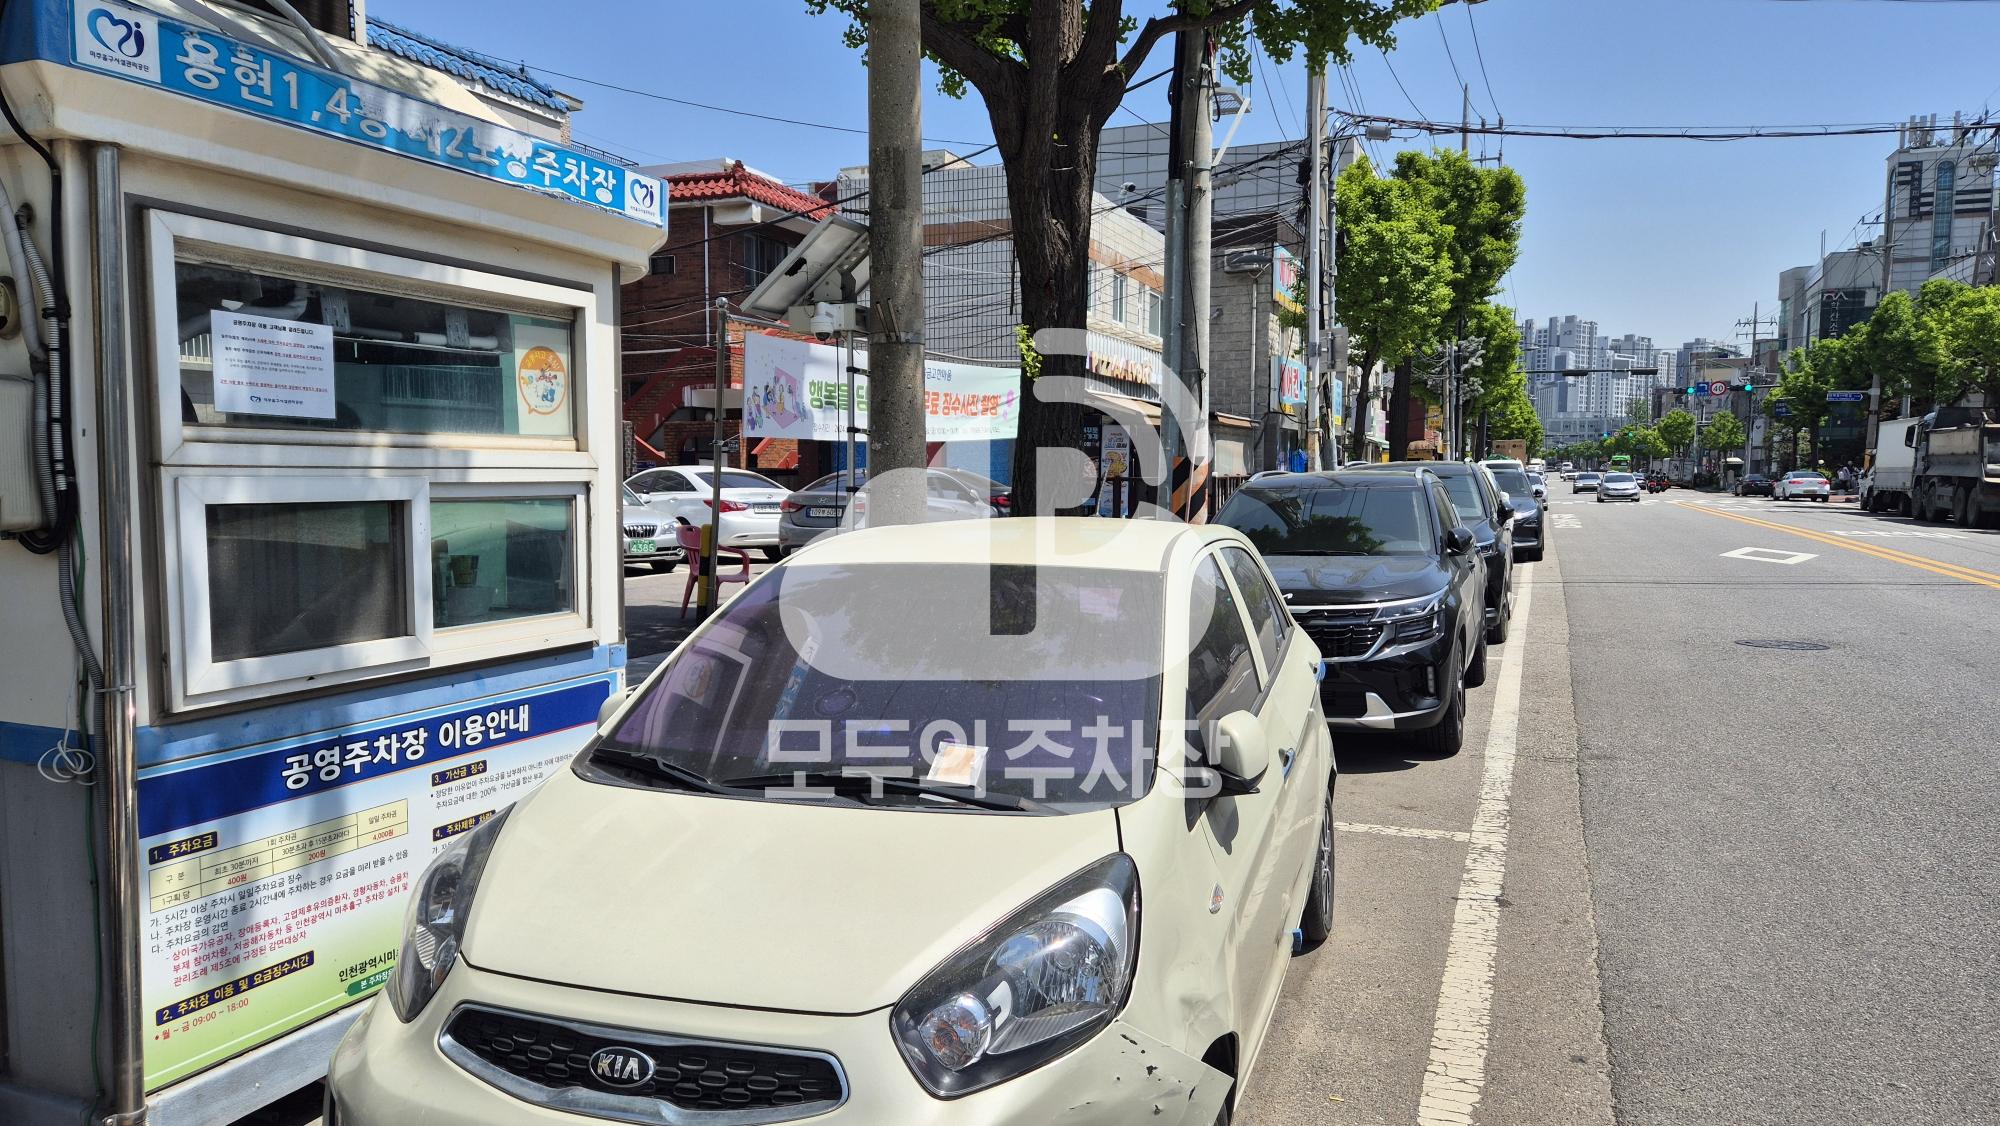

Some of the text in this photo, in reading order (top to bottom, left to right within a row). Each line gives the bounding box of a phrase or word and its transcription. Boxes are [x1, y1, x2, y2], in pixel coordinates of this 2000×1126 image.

[924, 367, 952, 382] 금고한마음
[1712, 384, 1724, 392] 40
[942, 392, 978, 417] 장수사진
[282, 704, 529, 790] 공영주차장 이용안내
[434, 762, 486, 784] 3. 가산금 징수
[436, 784, 454, 799] 정당한
[478, 771, 506, 787] 주차요금을
[506, 764, 528, 780] 납부하지
[528, 760, 543, 773] 아니한
[544, 758, 554, 768] 자에
[436, 795, 465, 811] 주차요금에
[466, 790, 478, 801] 대한
[480, 786, 497, 799] 200%
[500, 778, 522, 792] 가산금을
[368, 810, 397, 825] 일일 주차권
[436, 829, 443, 838] 4.
[447, 817, 476, 835] 주차제한
[278, 832, 297, 844] 주차권
[372, 829, 395, 841] 4,000원
[154, 835, 214, 861] 1. 주차요금
[282, 842, 307, 856] 30분초과
[308, 850, 326, 861] 200원
[231, 856, 259, 871] 30분까지
[228, 874, 248, 886] 400원
[150, 930, 163, 941] 나.
[166, 920, 192, 937] 주차장
[194, 909, 229, 928] 운영시간
[230, 902, 247, 916] 종료
[249, 890, 286, 909] 2시간내에
[288, 880, 318, 896] 주차하는
[320, 874, 334, 887] 경우
[335, 866, 356, 880] 요금을
[358, 861, 371, 872] 미리
[372, 856, 386, 868] 받을
[396, 849, 409, 861] 있음
[150, 873, 303, 928] 가. 5시간 이상 주차시 일일주차요금 징수
[162, 890, 191, 906] 1구획 당
[172, 932, 236, 962] 상이국가유공자,
[238, 916, 281, 938] 장애등록자,
[390, 870, 409, 884] 승용차
[173, 882, 409, 973] 부제 참여차량, 저공해자동차 등 인천광역시 미추홀구 주차장 설치 및
[152, 921, 229, 954] 다. 주차요금의 감면
[174, 930, 307, 987] 관리조례 제5조에 규정된 감면대상자
[338, 948, 399, 982] 인천광역시미
[162, 956, 310, 1021] 2. 주차장 이용 및 요금징수시간
[361, 980, 368, 990] 본
[162, 1028, 171, 1040] 월
[182, 1020, 191, 1032] 금
[192, 1012, 217, 1027] 09:00
[227, 998, 249, 1013] 18:00
[597, 1052, 640, 1081] KIA
